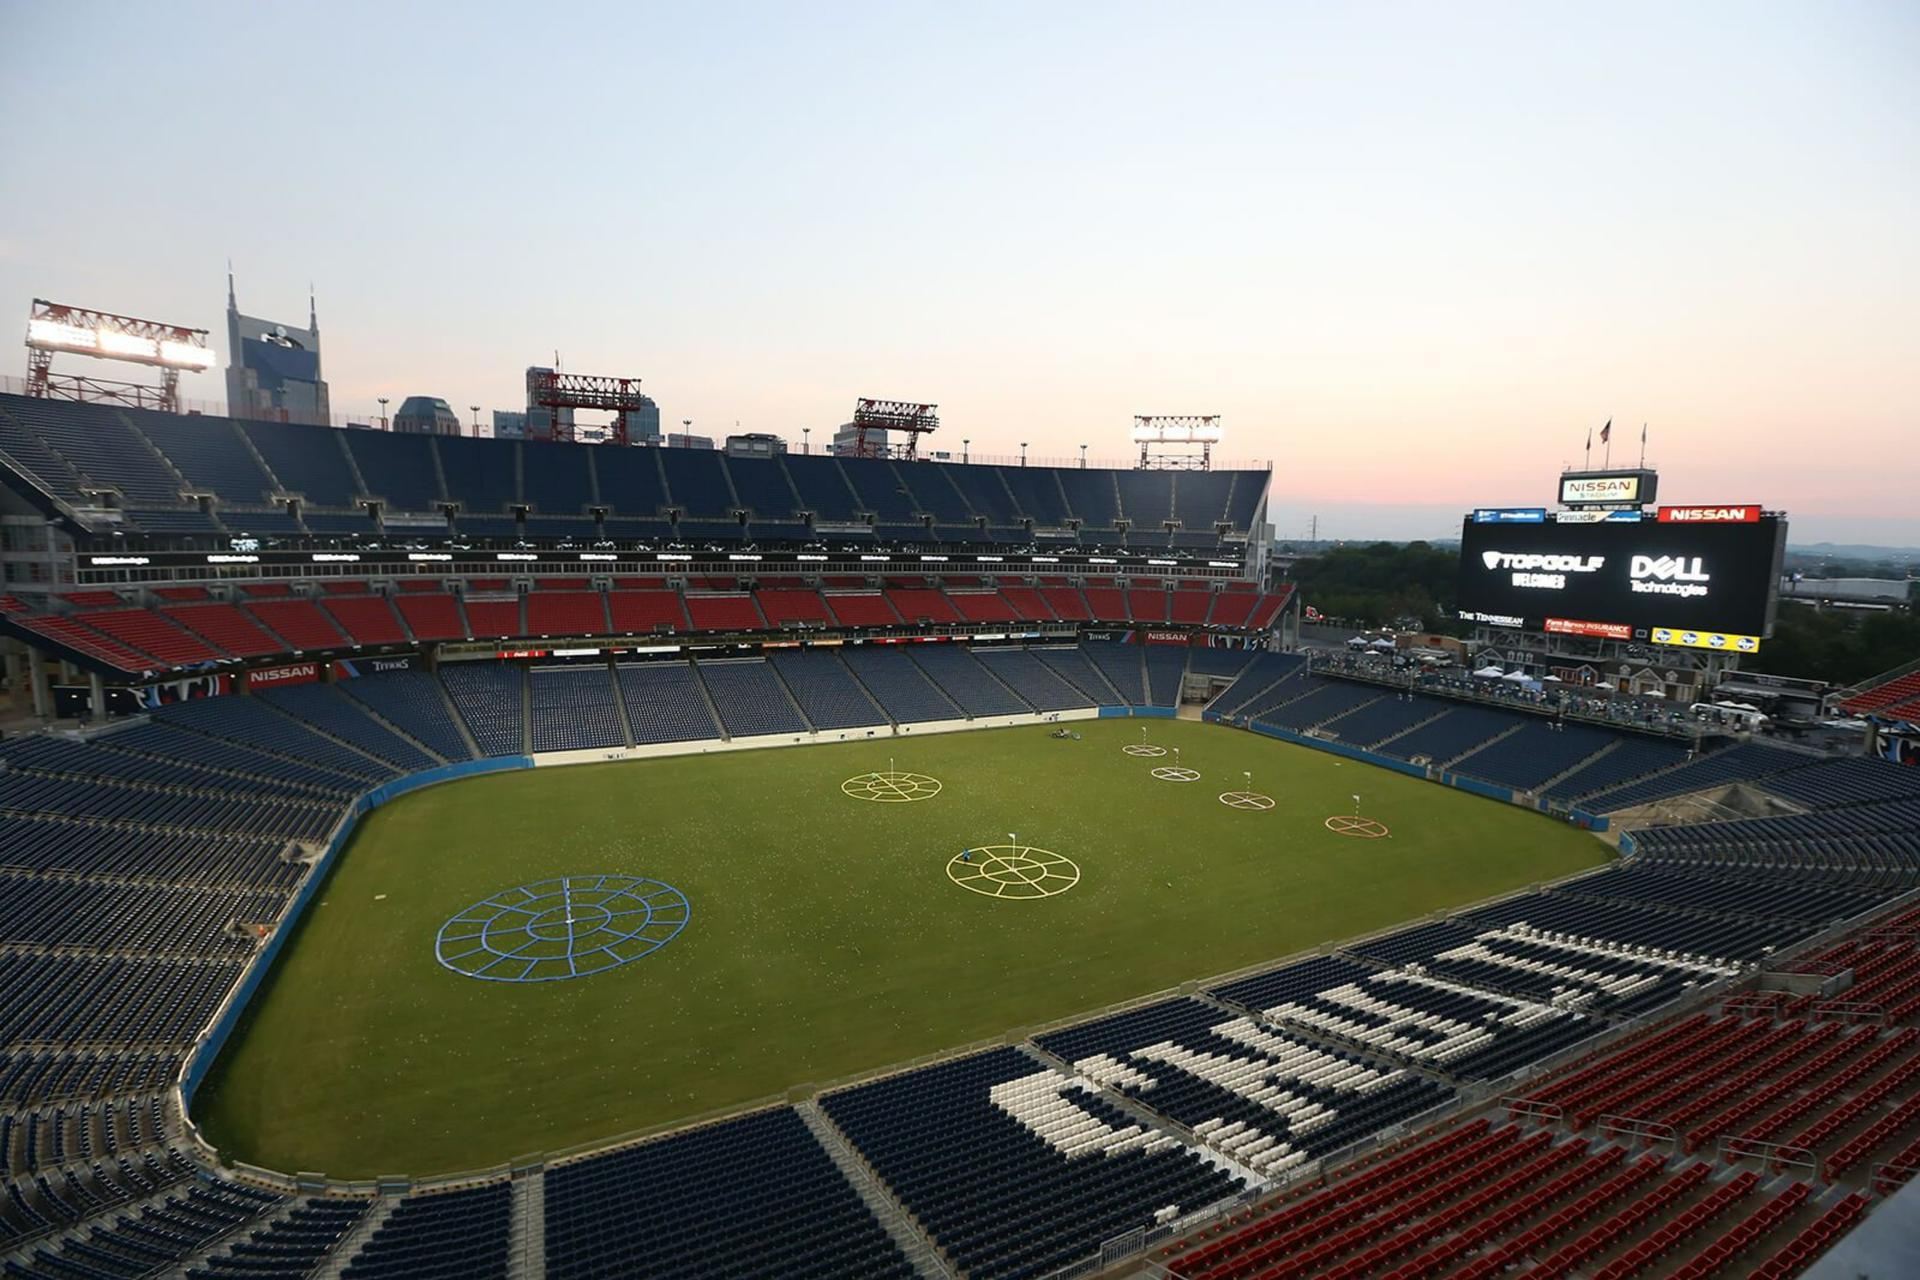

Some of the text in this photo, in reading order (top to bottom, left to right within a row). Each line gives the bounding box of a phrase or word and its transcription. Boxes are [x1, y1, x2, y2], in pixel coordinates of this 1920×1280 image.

[1569, 481, 1631, 492] NISSAN
[1669, 509, 1746, 520] NISSAN
[1500, 554, 1605, 572] TOPGOLF
[1631, 556, 1710, 580] DELL
[1630, 579, 1708, 598] Technologies
[1458, 610, 1475, 621] THE
[1475, 612, 1524, 625] TENNESSEAN
[1586, 623, 1630, 633] INSURANCE
[1148, 632, 1187, 641] NISSAN
[251, 666, 315, 682] NISSAN
